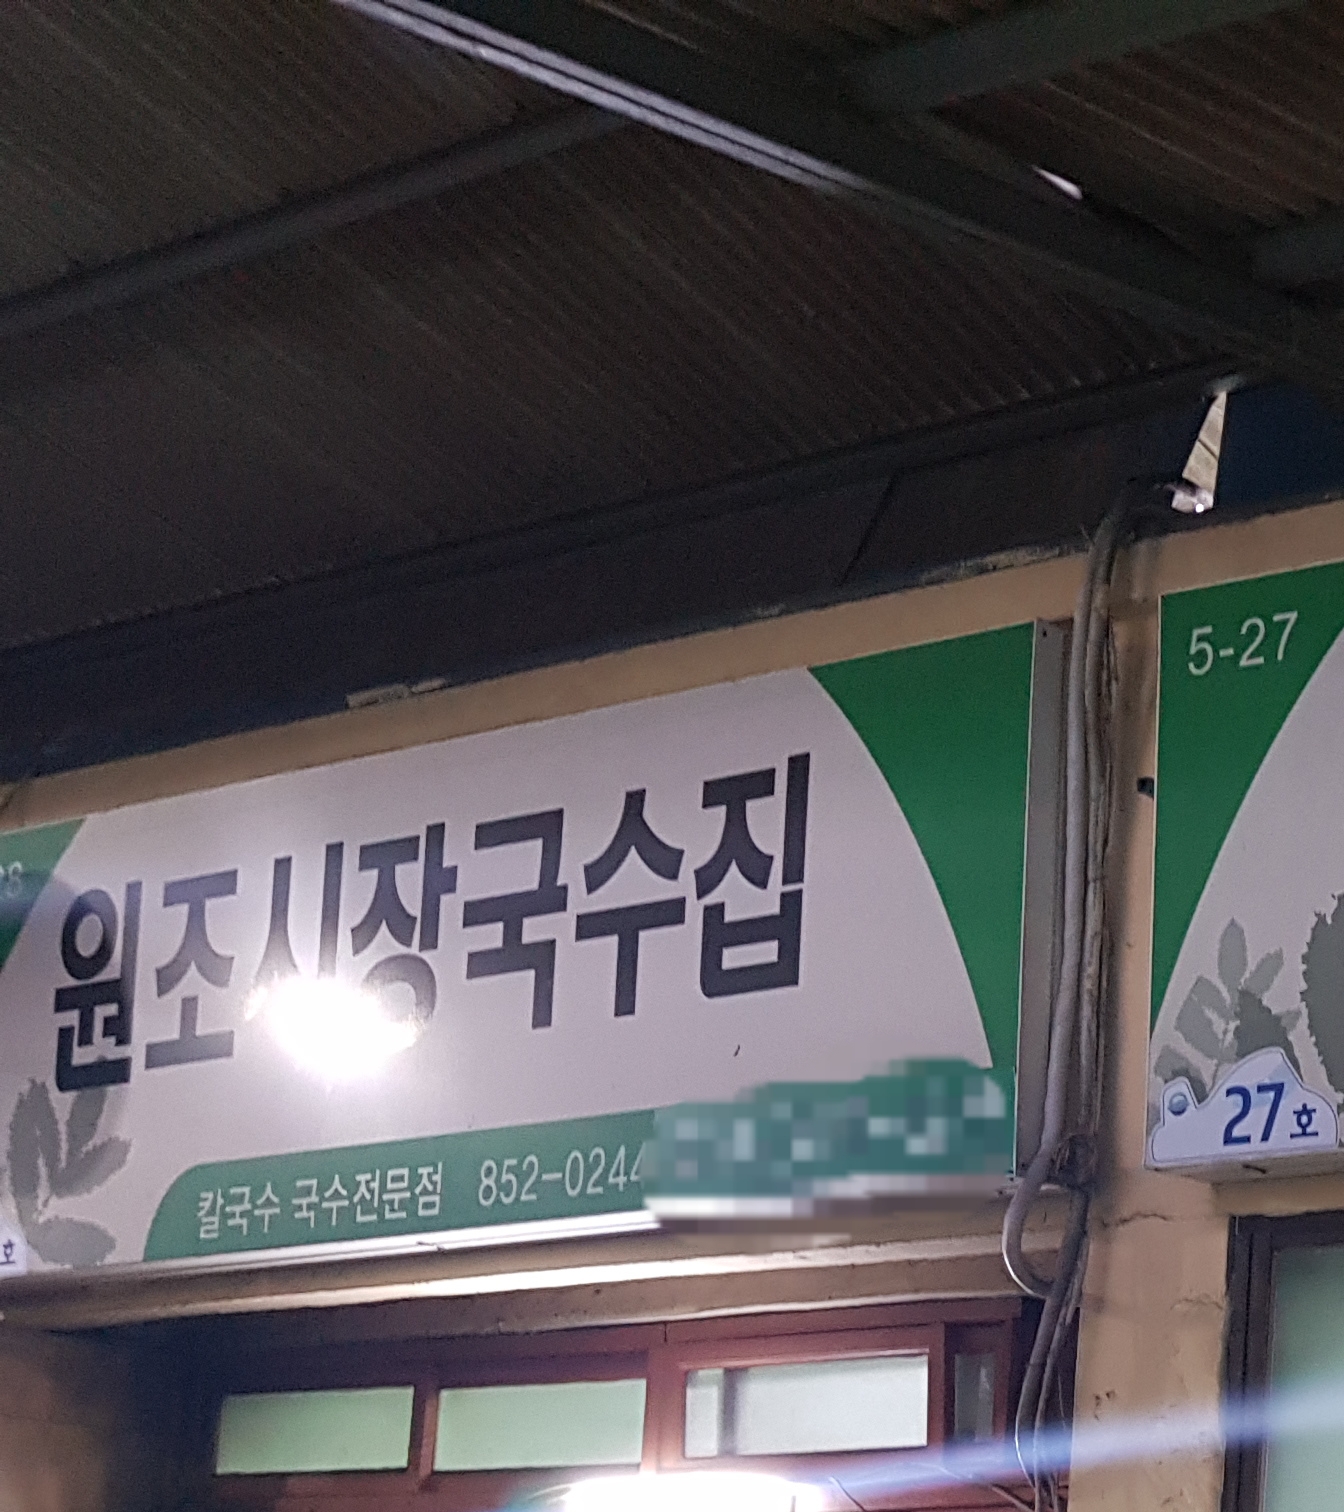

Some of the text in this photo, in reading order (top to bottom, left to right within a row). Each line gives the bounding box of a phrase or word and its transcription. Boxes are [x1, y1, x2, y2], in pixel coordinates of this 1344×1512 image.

[1187, 611, 1299, 676] 5-27
[53, 753, 811, 1093] 원조시장국수집
[1223, 1082, 1319, 1146] 27호
[197, 1182, 281, 1240] 칼국수
[292, 1161, 444, 1229] 국수전문점
